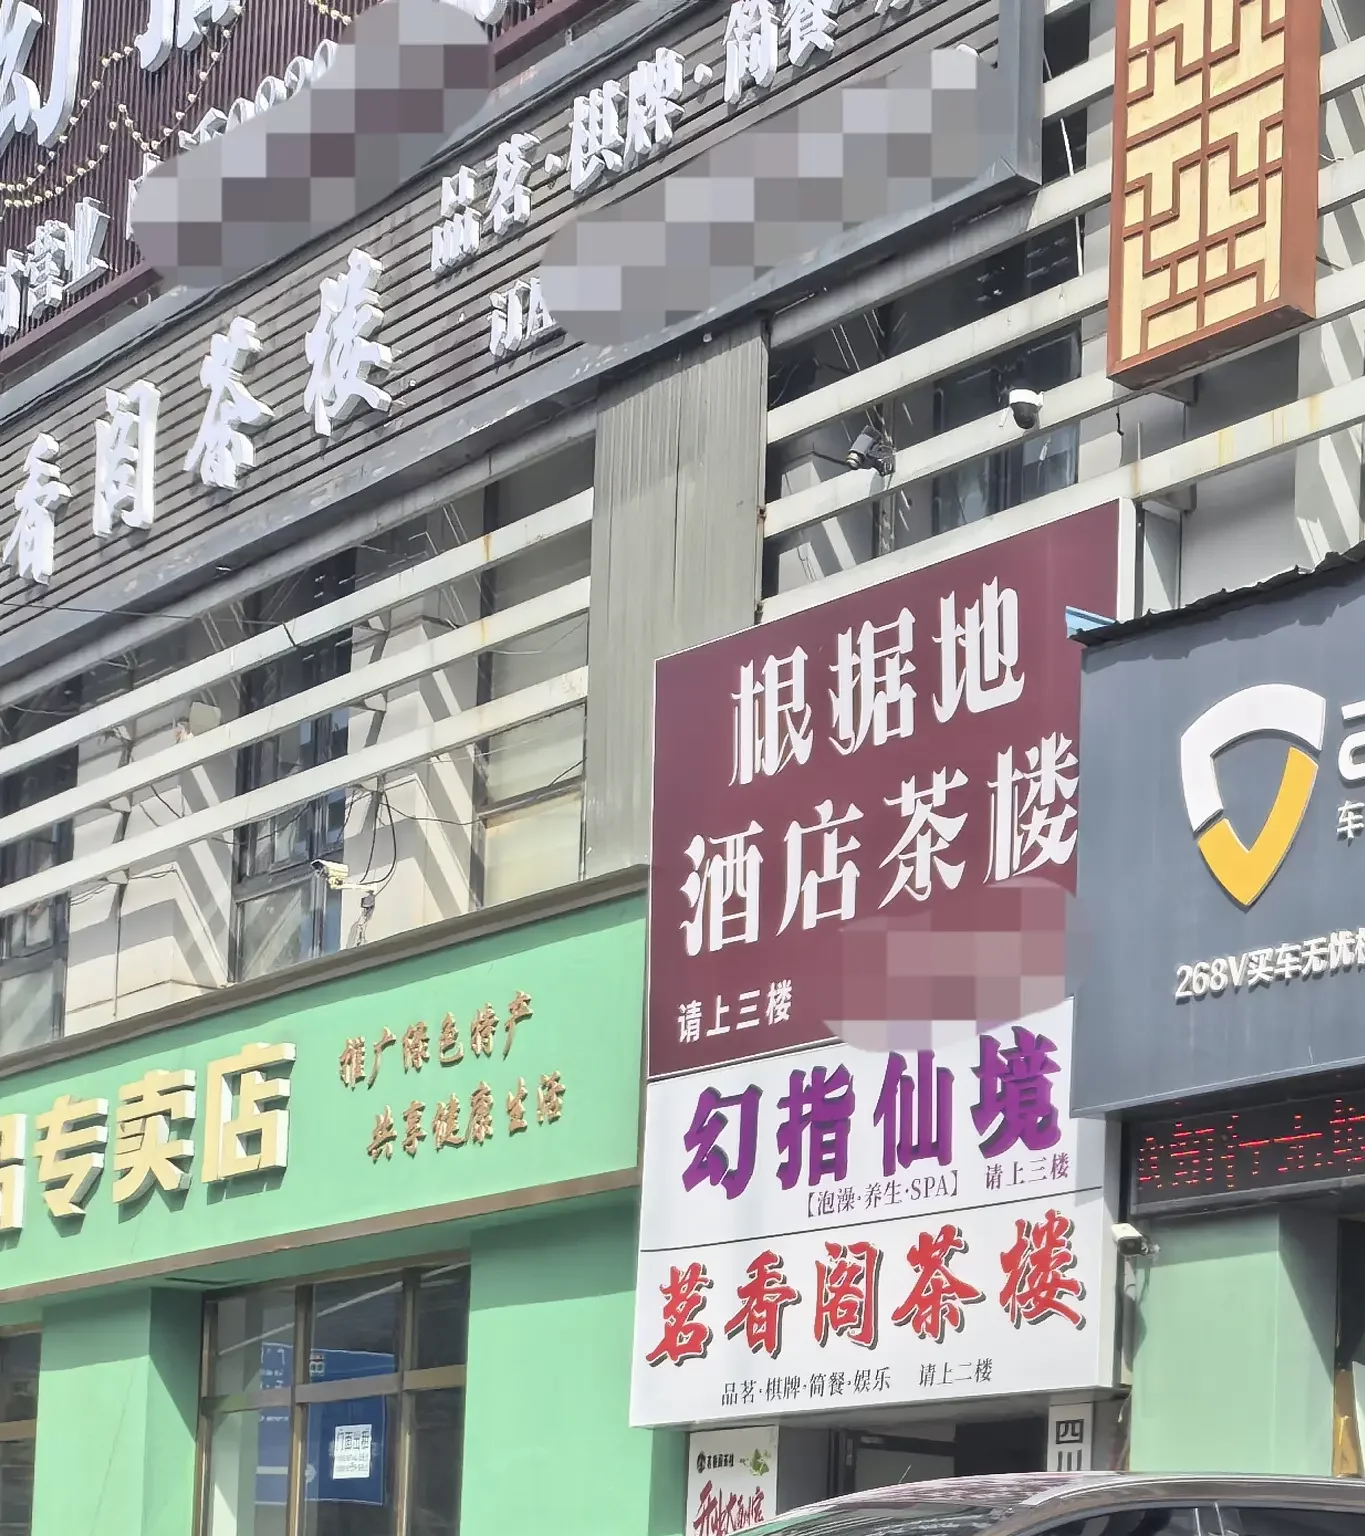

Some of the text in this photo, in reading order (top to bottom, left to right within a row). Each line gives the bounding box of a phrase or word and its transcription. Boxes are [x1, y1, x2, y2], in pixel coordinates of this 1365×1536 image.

[729, 576, 1026, 787] 根据地
[678, 731, 1080, 957] 酒店茶楼
[339, 990, 534, 1090] 推广绿色特产
[677, 979, 793, 1044] 请上三楼
[368, 1069, 566, 1163] 共享健康生活
[682, 1025, 1063, 1200] 幻指仙境
[984, 1151, 1070, 1192] 请上三楼
[646, 1208, 1088, 1368] 茗香阁茶楼
[918, 1357, 994, 1387] 请上二楼
